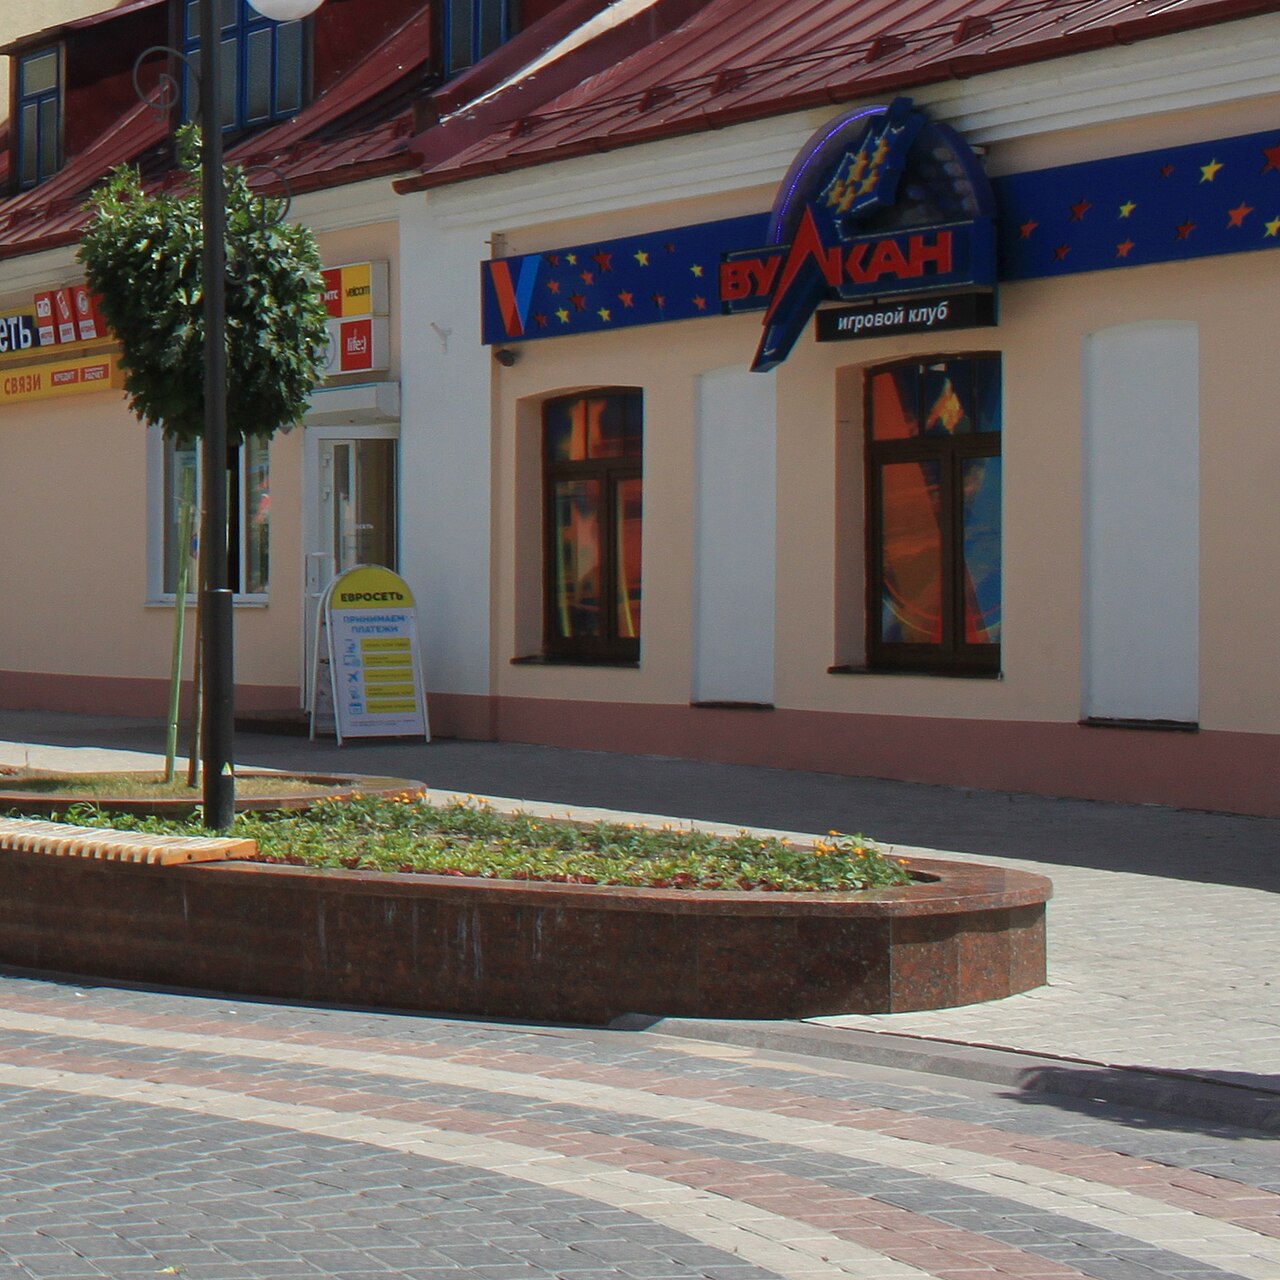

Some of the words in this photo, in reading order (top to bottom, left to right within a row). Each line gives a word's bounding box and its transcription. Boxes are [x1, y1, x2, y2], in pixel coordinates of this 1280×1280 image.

[720, 205, 953, 324] ВУЛКАН
[838, 306, 904, 332] игровой
[908, 301, 948, 326] клуб
[4, 373, 41, 395] СВЯЗИ
[341, 591, 404, 602] ЕВРОСЕТЬ
[343, 615, 405, 623] ПРИНИМАЕМ
[351, 625, 400, 633] ПЛАТЕЖИ
